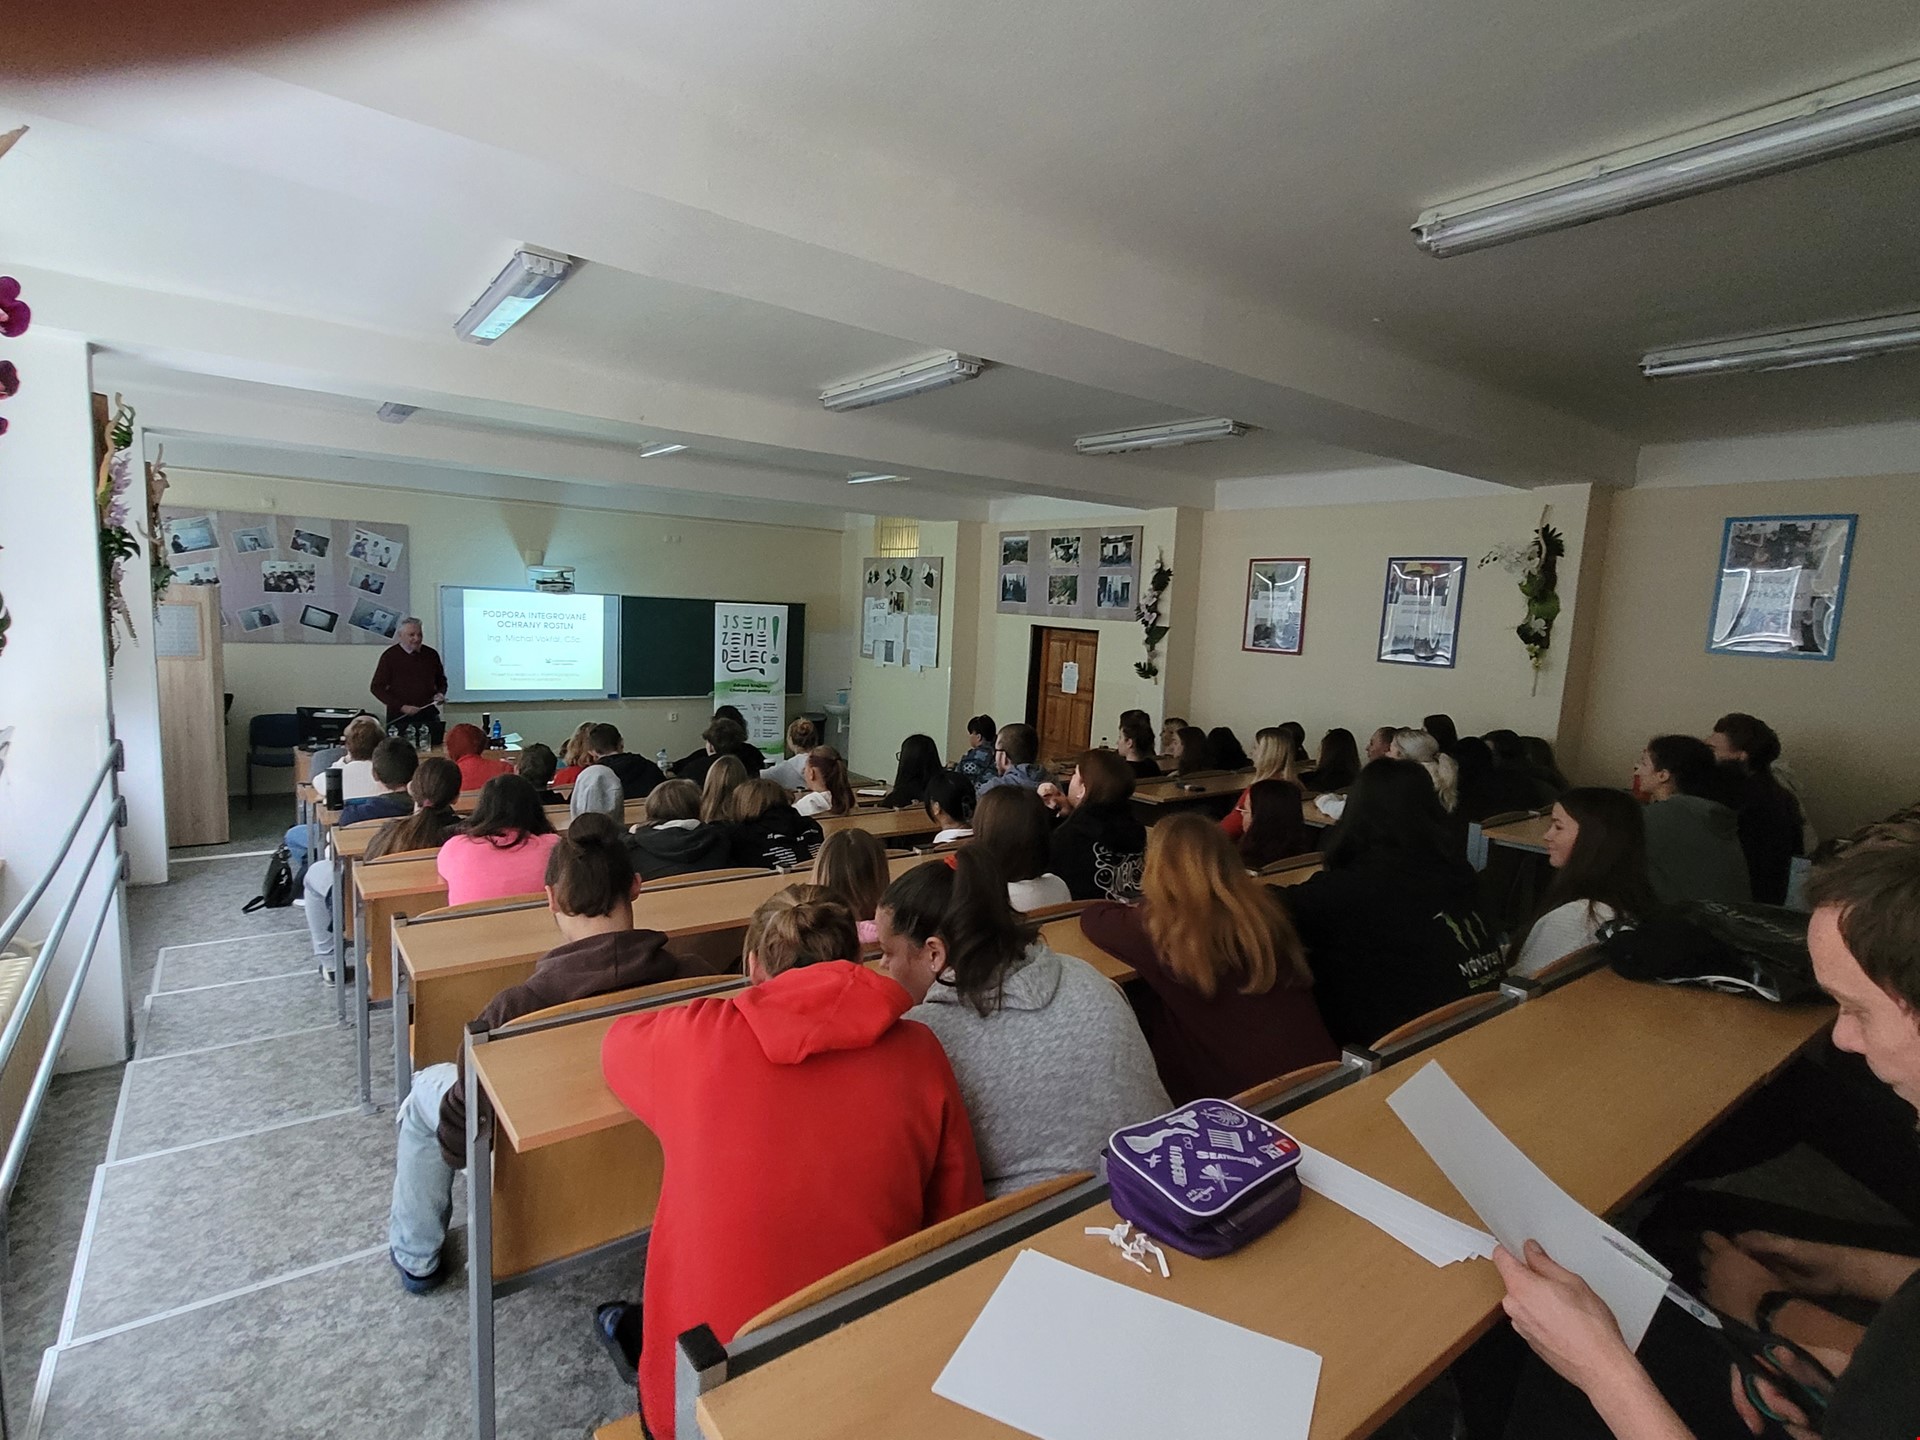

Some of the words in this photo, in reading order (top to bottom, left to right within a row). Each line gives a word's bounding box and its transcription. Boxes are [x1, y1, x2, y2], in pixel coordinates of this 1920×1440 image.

[482, 610, 526, 619] PODPORA
[722, 614, 767, 631] JSEM
[496, 620, 542, 629] OCHRANY
[721, 631, 767, 647] ZEMĚ
[721, 647, 768, 666] DĚLEC
